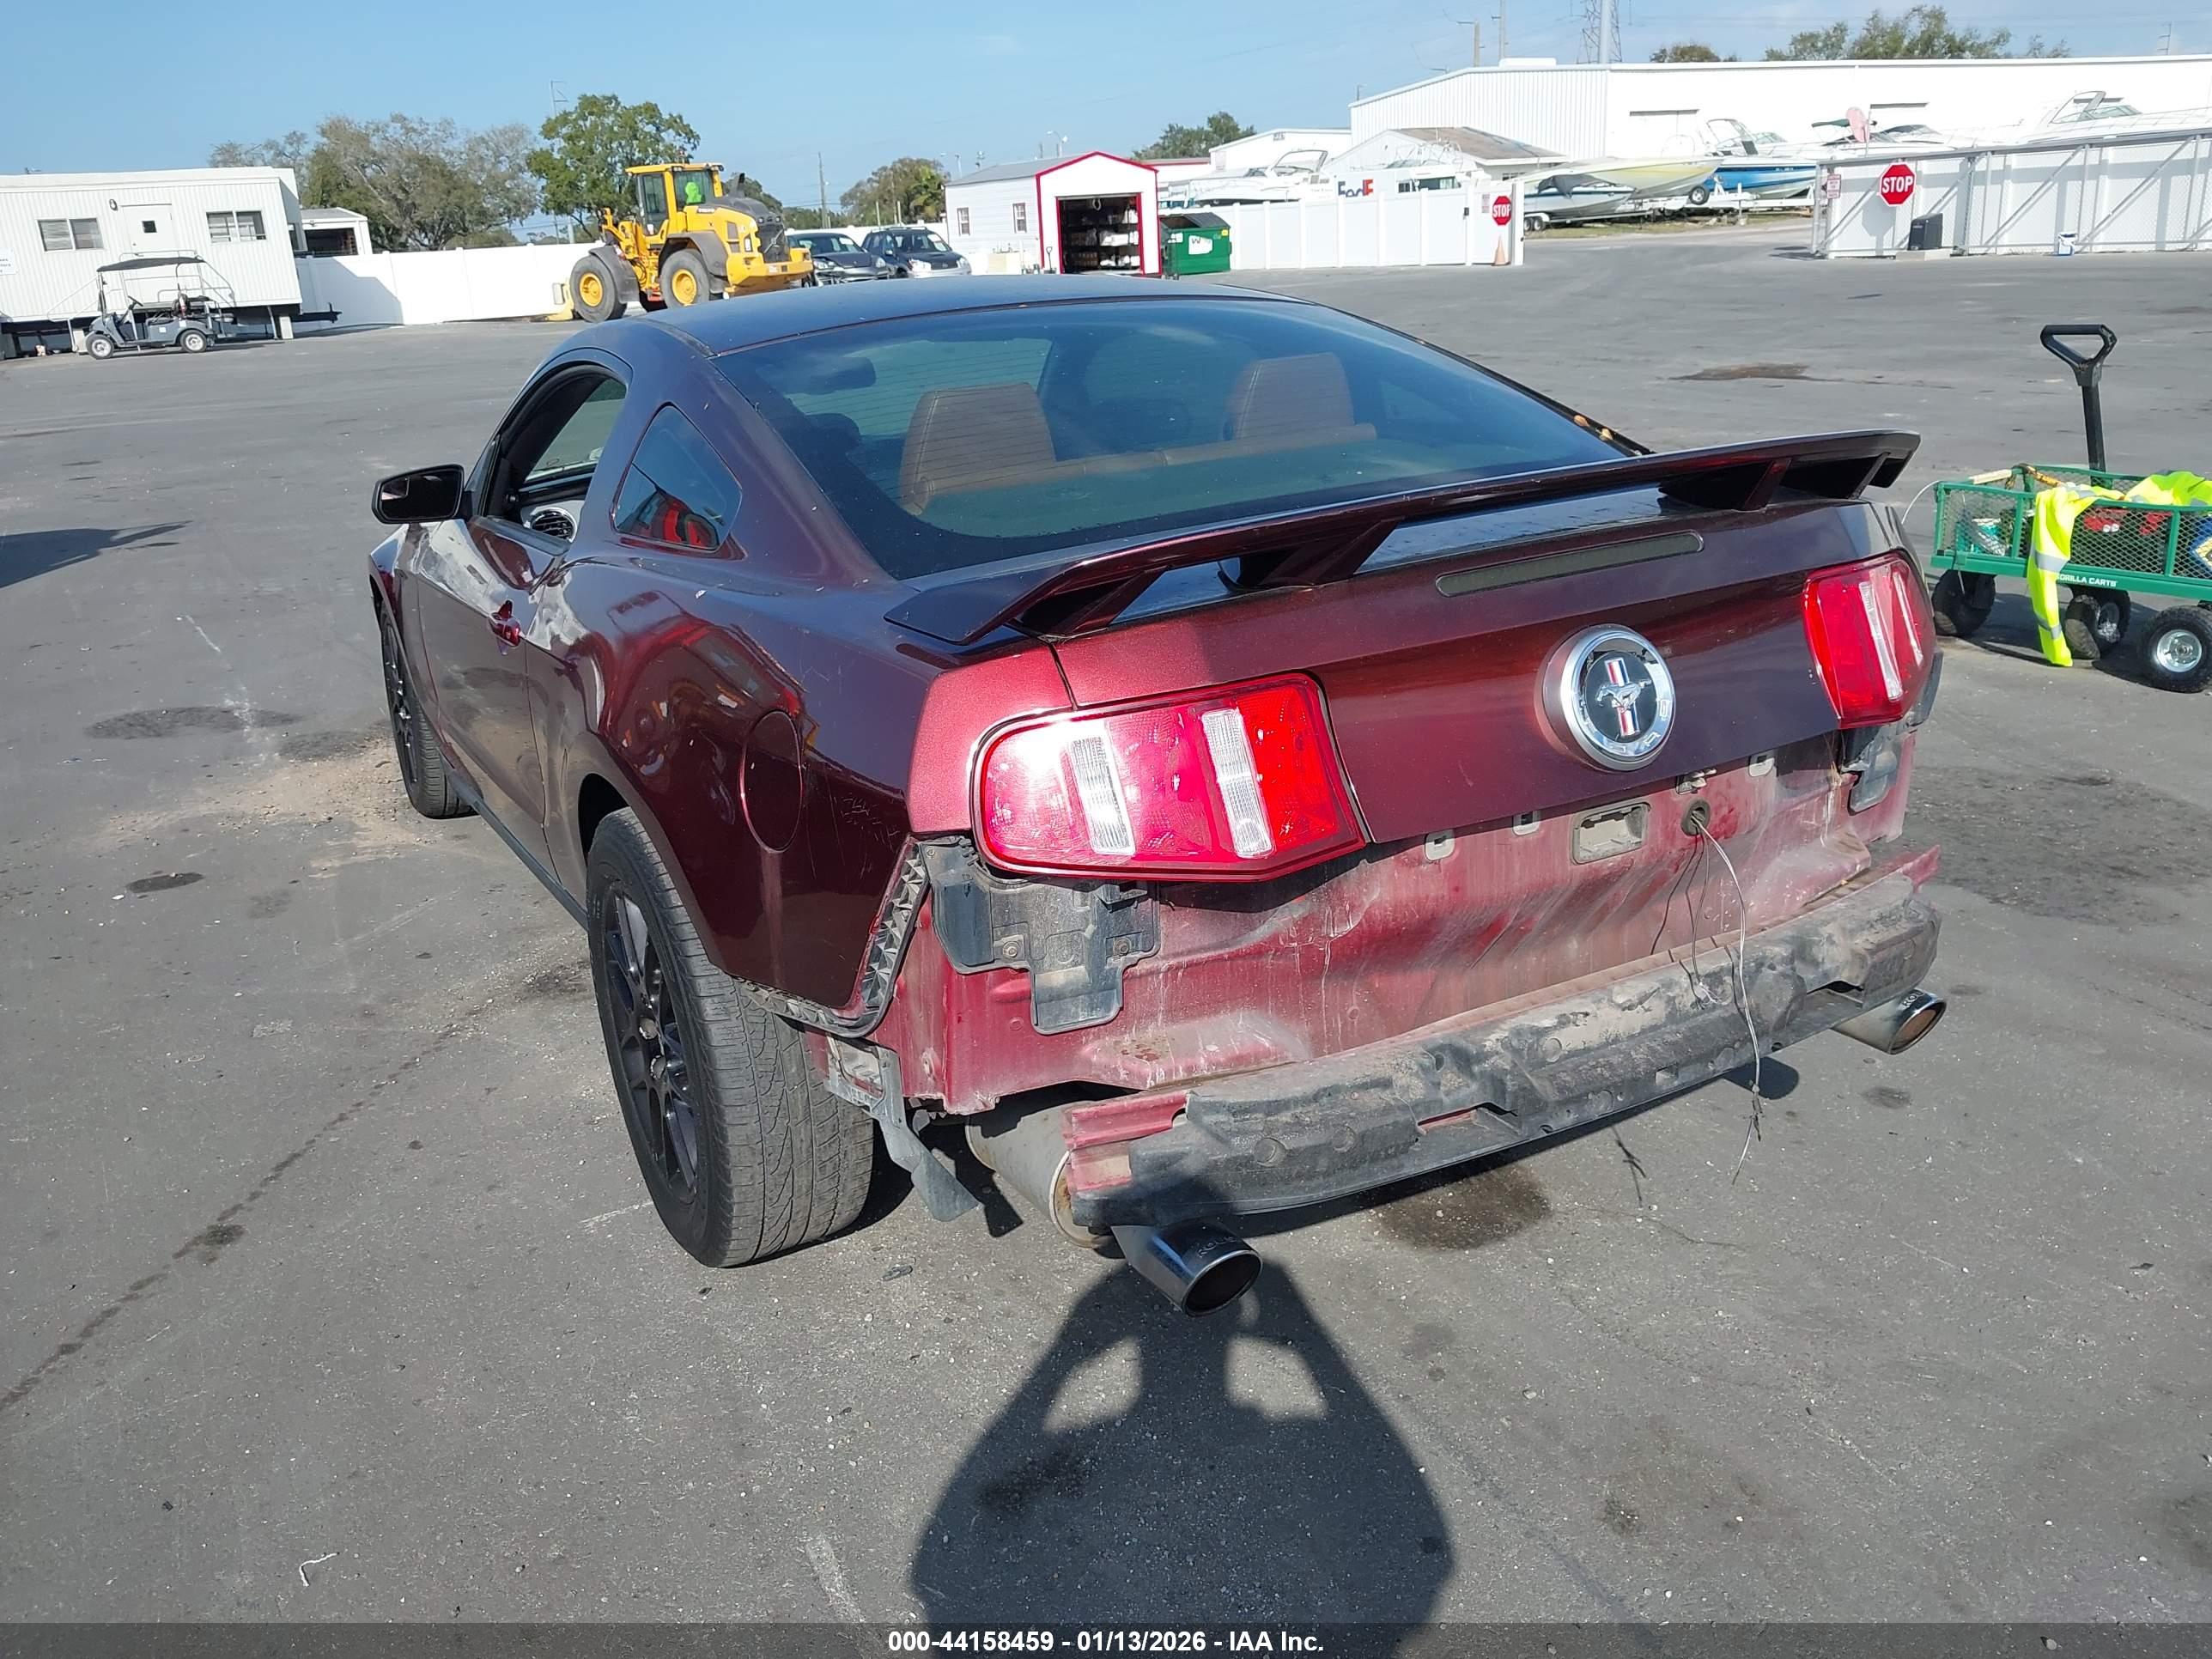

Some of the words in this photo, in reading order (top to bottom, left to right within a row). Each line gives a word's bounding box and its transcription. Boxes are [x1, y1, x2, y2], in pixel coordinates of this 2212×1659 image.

[1882, 175, 1913, 193] STOP
[1493, 204, 1511, 217] STOP
[2059, 573, 2087, 585] ORILLA
[2088, 576, 2117, 587] CARTS
